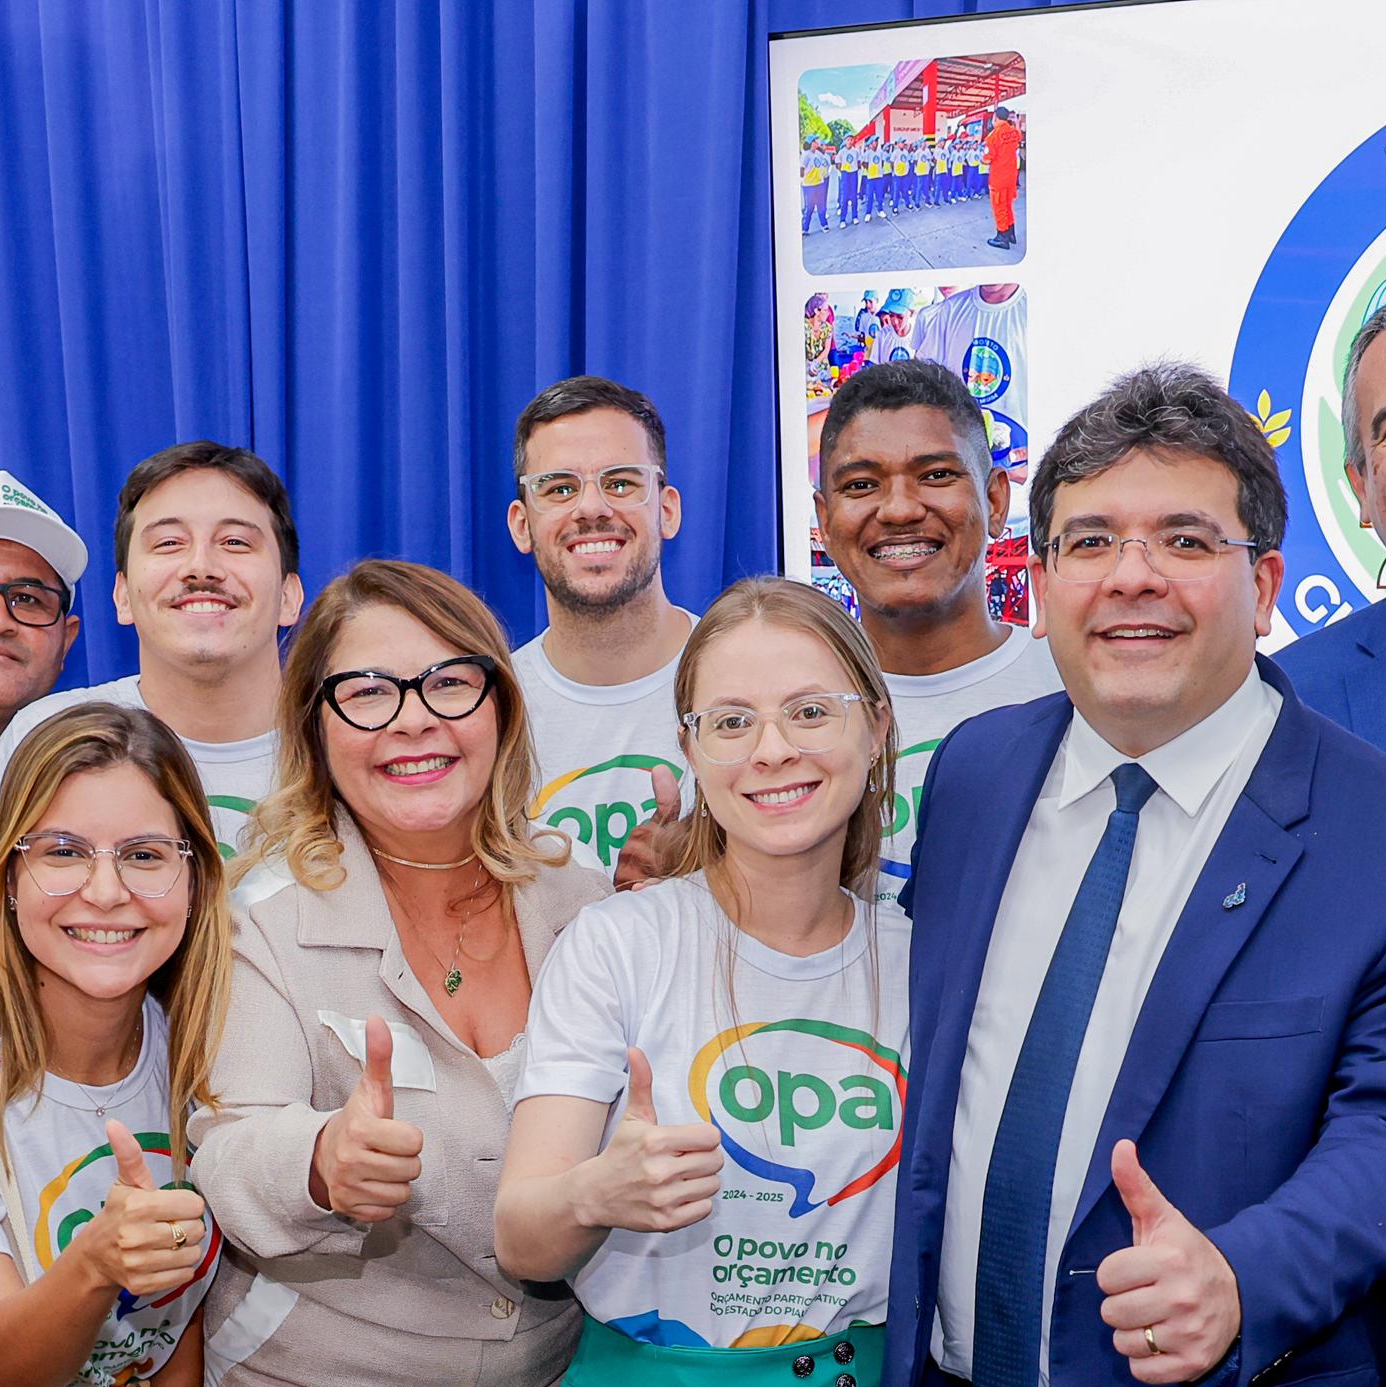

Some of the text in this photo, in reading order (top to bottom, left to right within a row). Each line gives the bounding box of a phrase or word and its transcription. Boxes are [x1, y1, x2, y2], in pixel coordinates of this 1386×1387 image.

[718, 1065, 894, 1147] opa
[722, 1190, 747, 1200] 2024
[756, 1192, 784, 1202] 2025
[713, 1234, 848, 1260] O povo no
[713, 1263, 857, 1288] orçamento
[710, 1292, 849, 1307] ORÇAMENTO PARTICATIVO
[724, 1305, 763, 1318] ESTADO
[765, 1306, 782, 1315] DO
[784, 1306, 805, 1318] PIA
